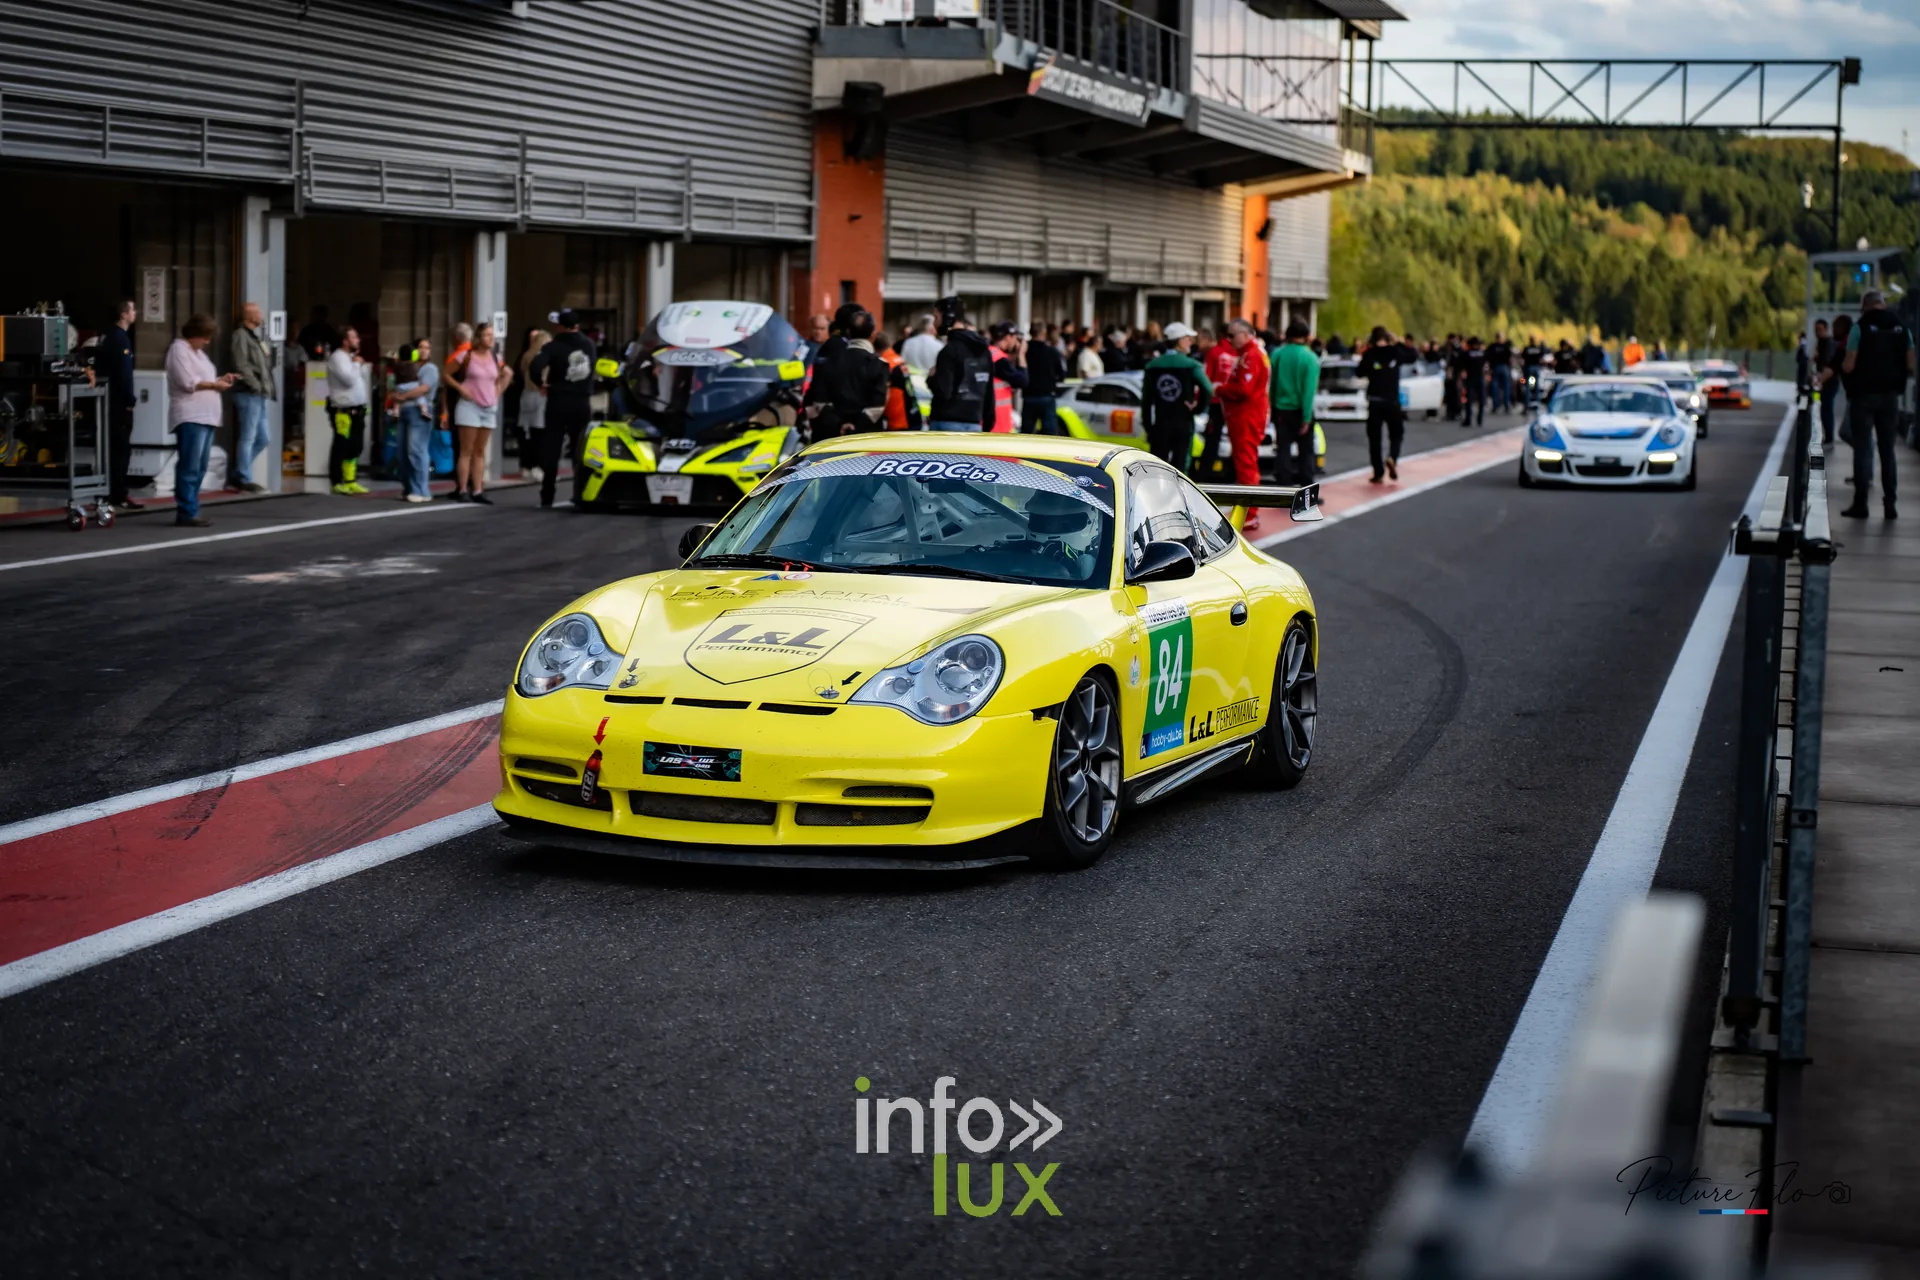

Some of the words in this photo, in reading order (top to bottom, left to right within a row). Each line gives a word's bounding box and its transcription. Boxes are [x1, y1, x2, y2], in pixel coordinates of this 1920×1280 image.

[869, 459, 999, 482] BGDC.be
[773, 588, 911, 604] CAPITAL
[705, 623, 829, 649] L&L
[696, 644, 818, 656] Performance
[1155, 634, 1183, 715] 84
[1189, 711, 1214, 743] L&L
[1216, 699, 1259, 731] PERFORMANCE
[1152, 728, 1182, 749] hobby-alu.be
